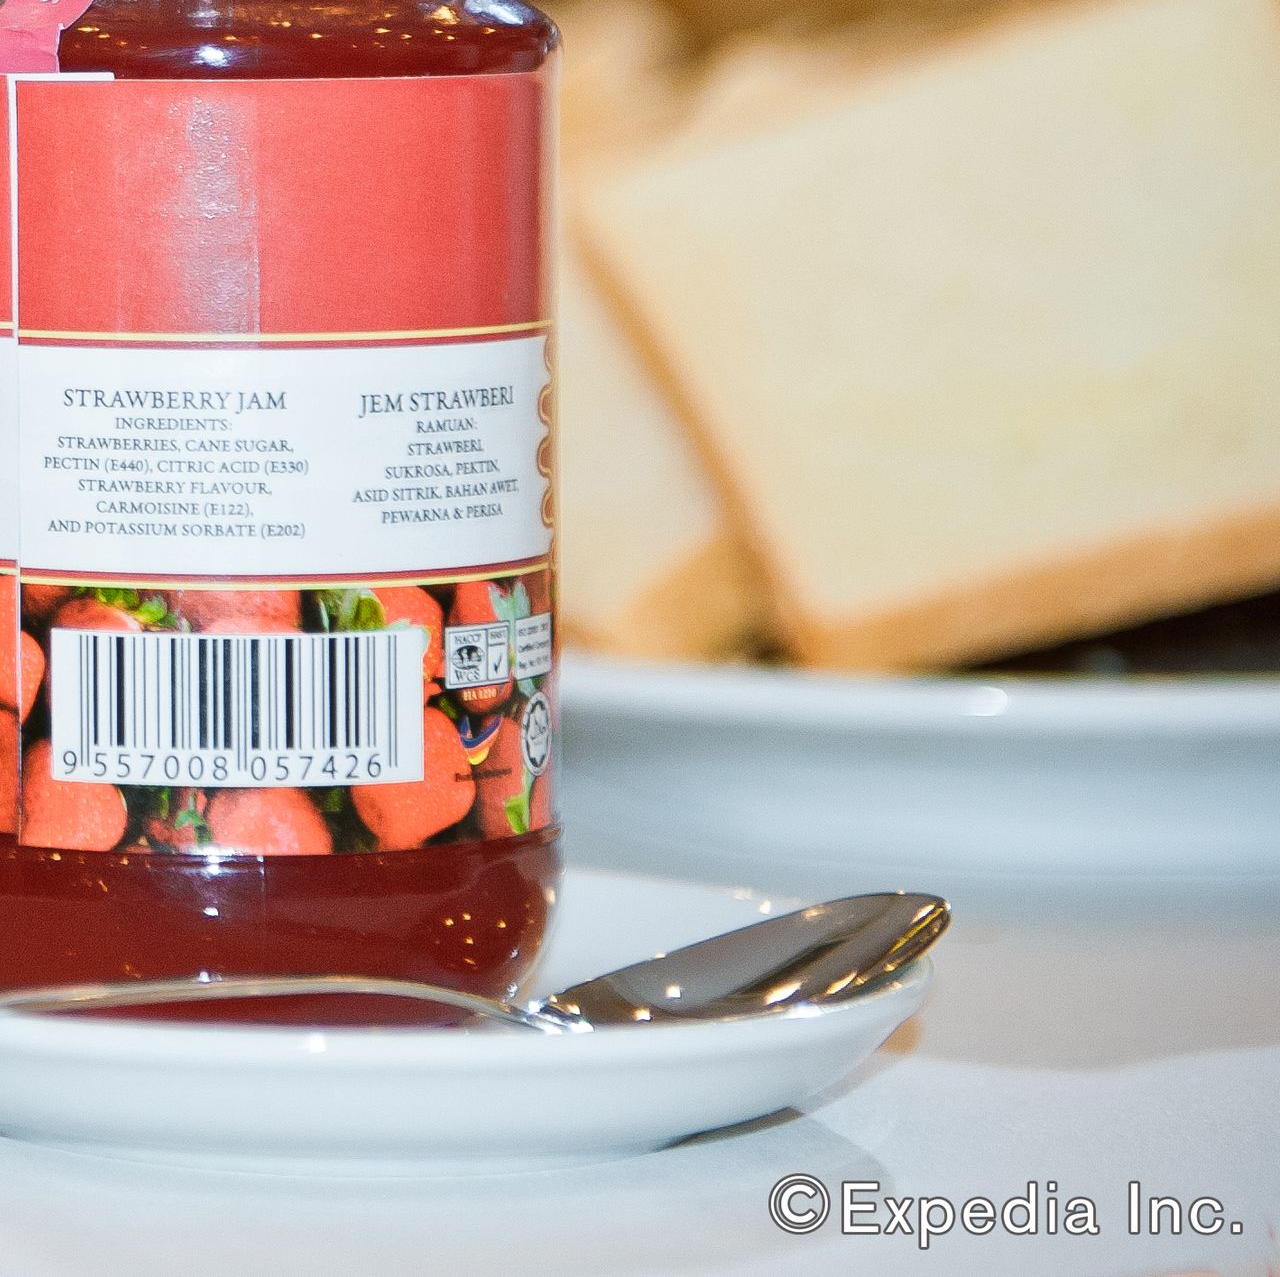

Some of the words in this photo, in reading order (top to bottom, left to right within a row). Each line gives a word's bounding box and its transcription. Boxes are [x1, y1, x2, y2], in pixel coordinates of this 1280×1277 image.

[63, 389, 231, 410] STRAWBERRY
[235, 391, 288, 415] JAM
[358, 393, 404, 419] JEM
[409, 385, 514, 412] STRAWBERI
[115, 417, 233, 431] INGREDIENTS:
[416, 417, 478, 434] RAMUAN:
[57, 436, 181, 453] STRAWBERRIES,
[185, 439, 230, 453] CANE
[234, 439, 294, 454] SUGAR,
[44, 456, 100, 471] PECTIN
[104, 458, 153, 474] (E440),
[156, 460, 216, 473] CITRIC
[219, 461, 260, 474] ACID
[263, 460, 309, 475] (E330)
[78, 479, 186, 494] STRAWBERRY
[190, 481, 273, 496] FLAVOUR,
[352, 489, 389, 503] ASID
[445, 482, 488, 499] BAHAN
[95, 501, 200, 515] CARMOISINE
[382, 508, 450, 524] PEWARNA
[453, 507, 465, 520] &
[466, 503, 504, 519] PERISA
[47, 520, 81, 534] AND
[85, 522, 178, 536] POTASSIUM
[181, 523, 257, 537] SORBATE
[260, 523, 306, 540] (E202)
[63, 750, 77, 775] 9
[93, 752, 228, 782] 557008
[251, 753, 382, 781] 057426
